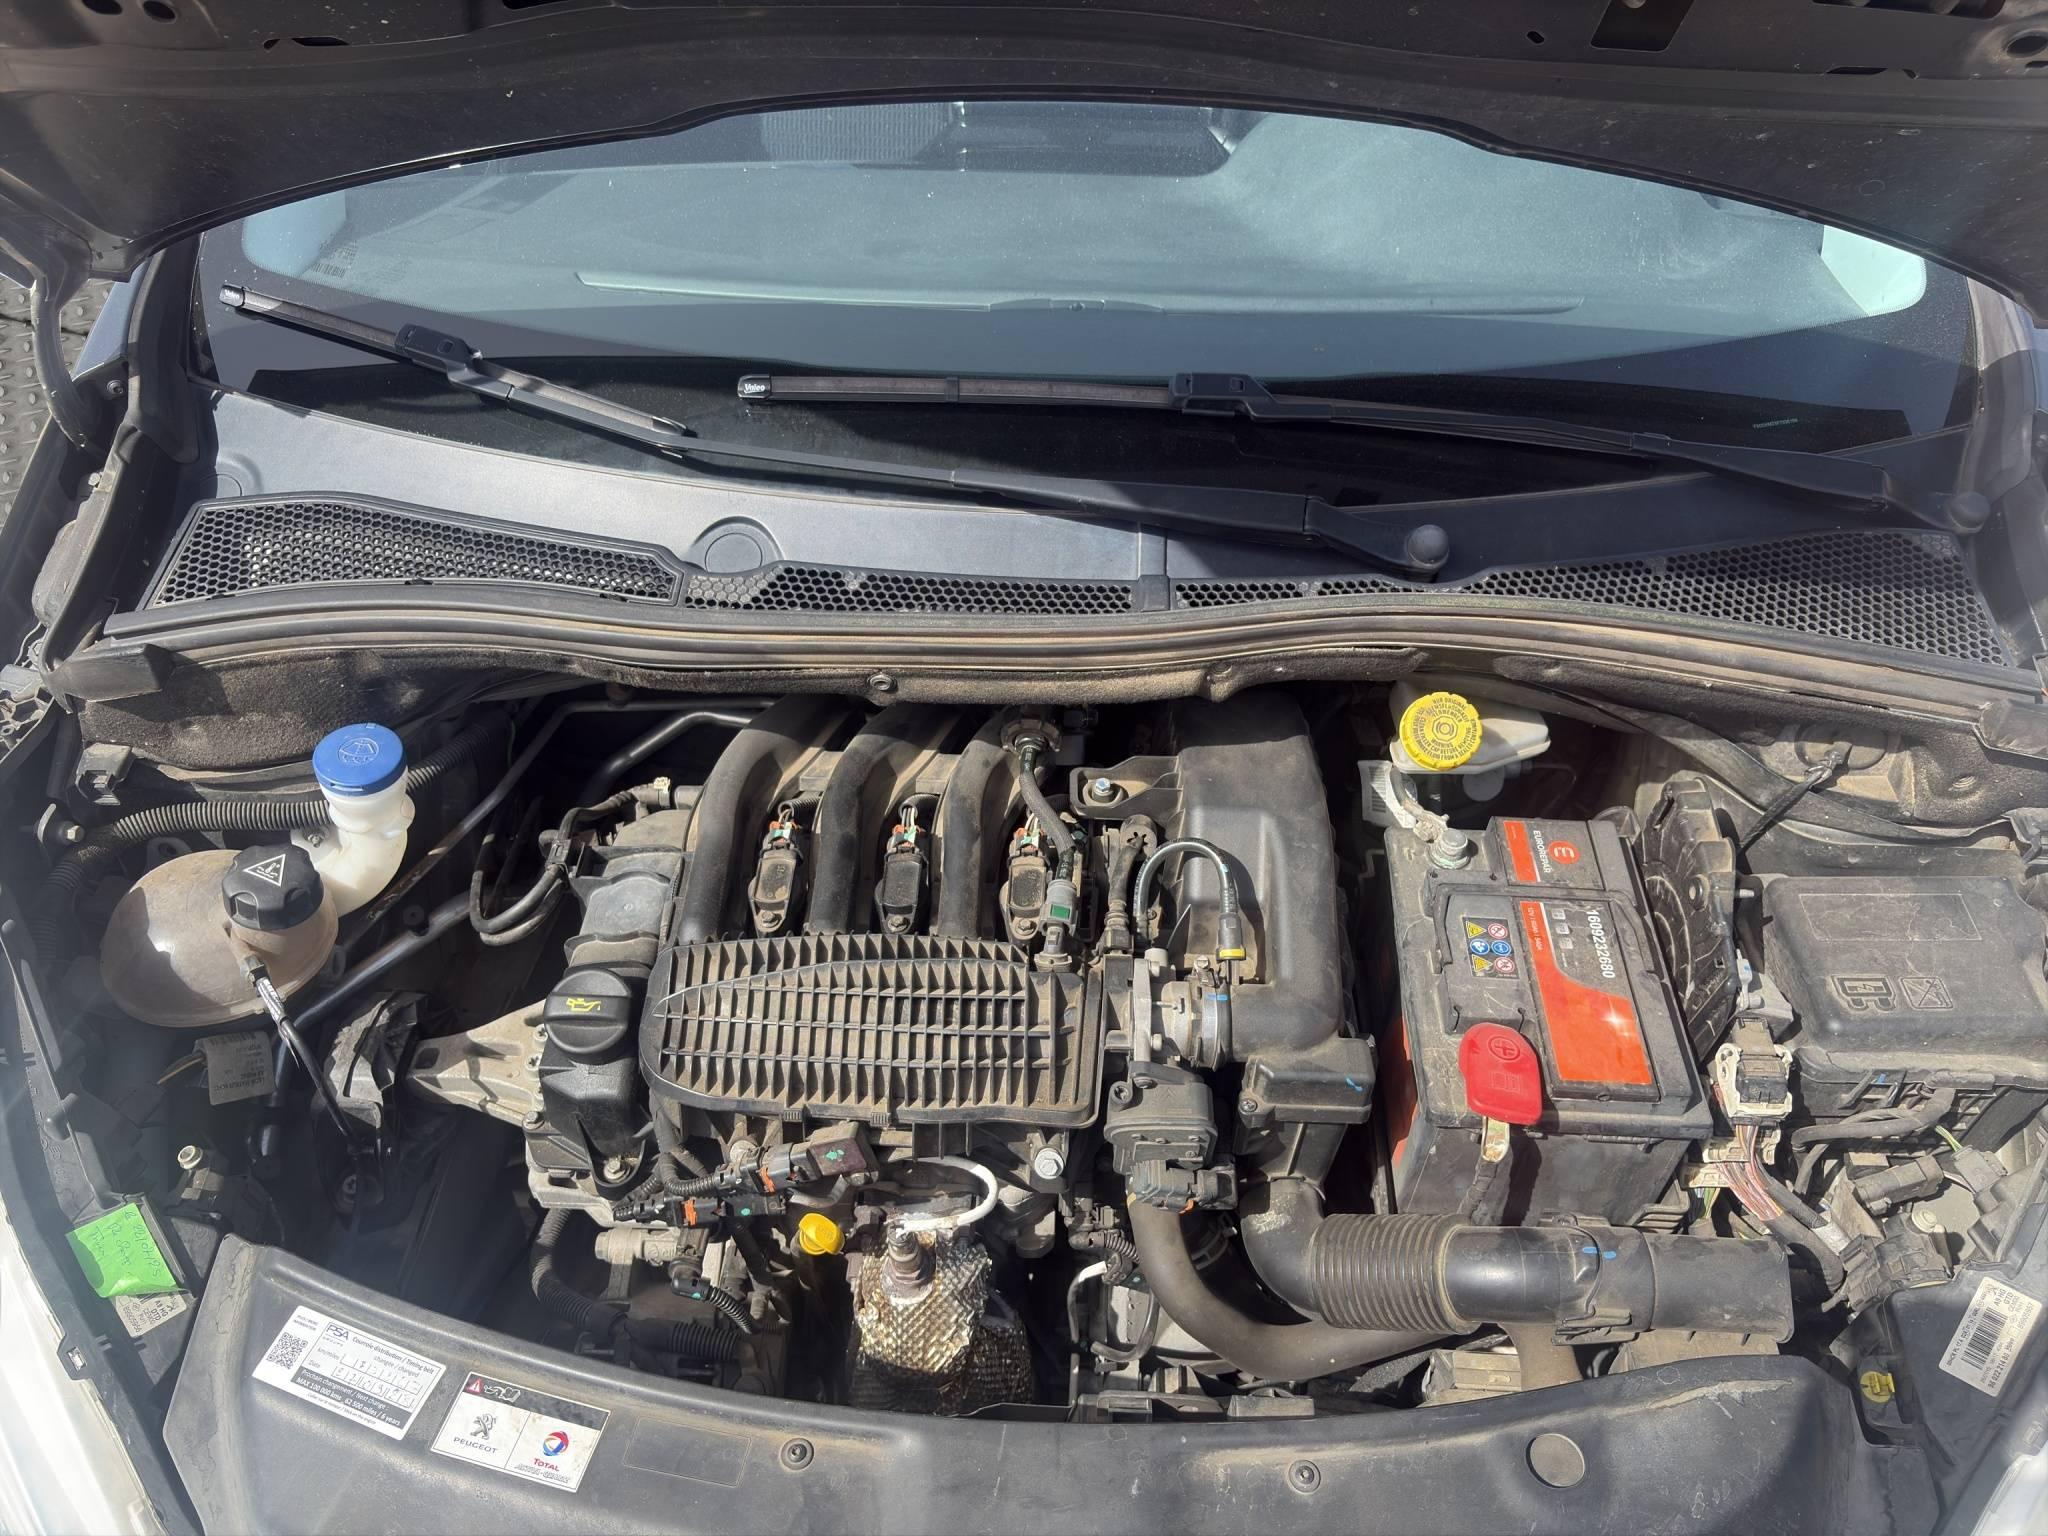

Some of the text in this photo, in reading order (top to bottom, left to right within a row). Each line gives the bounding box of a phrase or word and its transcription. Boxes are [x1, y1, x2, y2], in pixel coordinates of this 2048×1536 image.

[744, 384, 766, 394] Valeo
[1532, 829, 1552, 874] EUROREPAR
[1586, 910, 1616, 978] 1609232680
[326, 1324, 350, 1340] PSA
[372, 1344, 403, 1362] distribution
[422, 1365, 434, 1375] belt
[295, 1376, 310, 1387] MAX
[309, 1382, 321, 1392] 100
[361, 1404, 378, 1416] miles
[384, 1415, 401, 1427] years
[301, 1367, 323, 1382] Prochain
[320, 1376, 353, 1396] changement
[355, 1391, 368, 1401] Next
[365, 1396, 386, 1411] change
[454, 1436, 498, 1454] PEUGEOT
[533, 1458, 560, 1472] TOTAL
